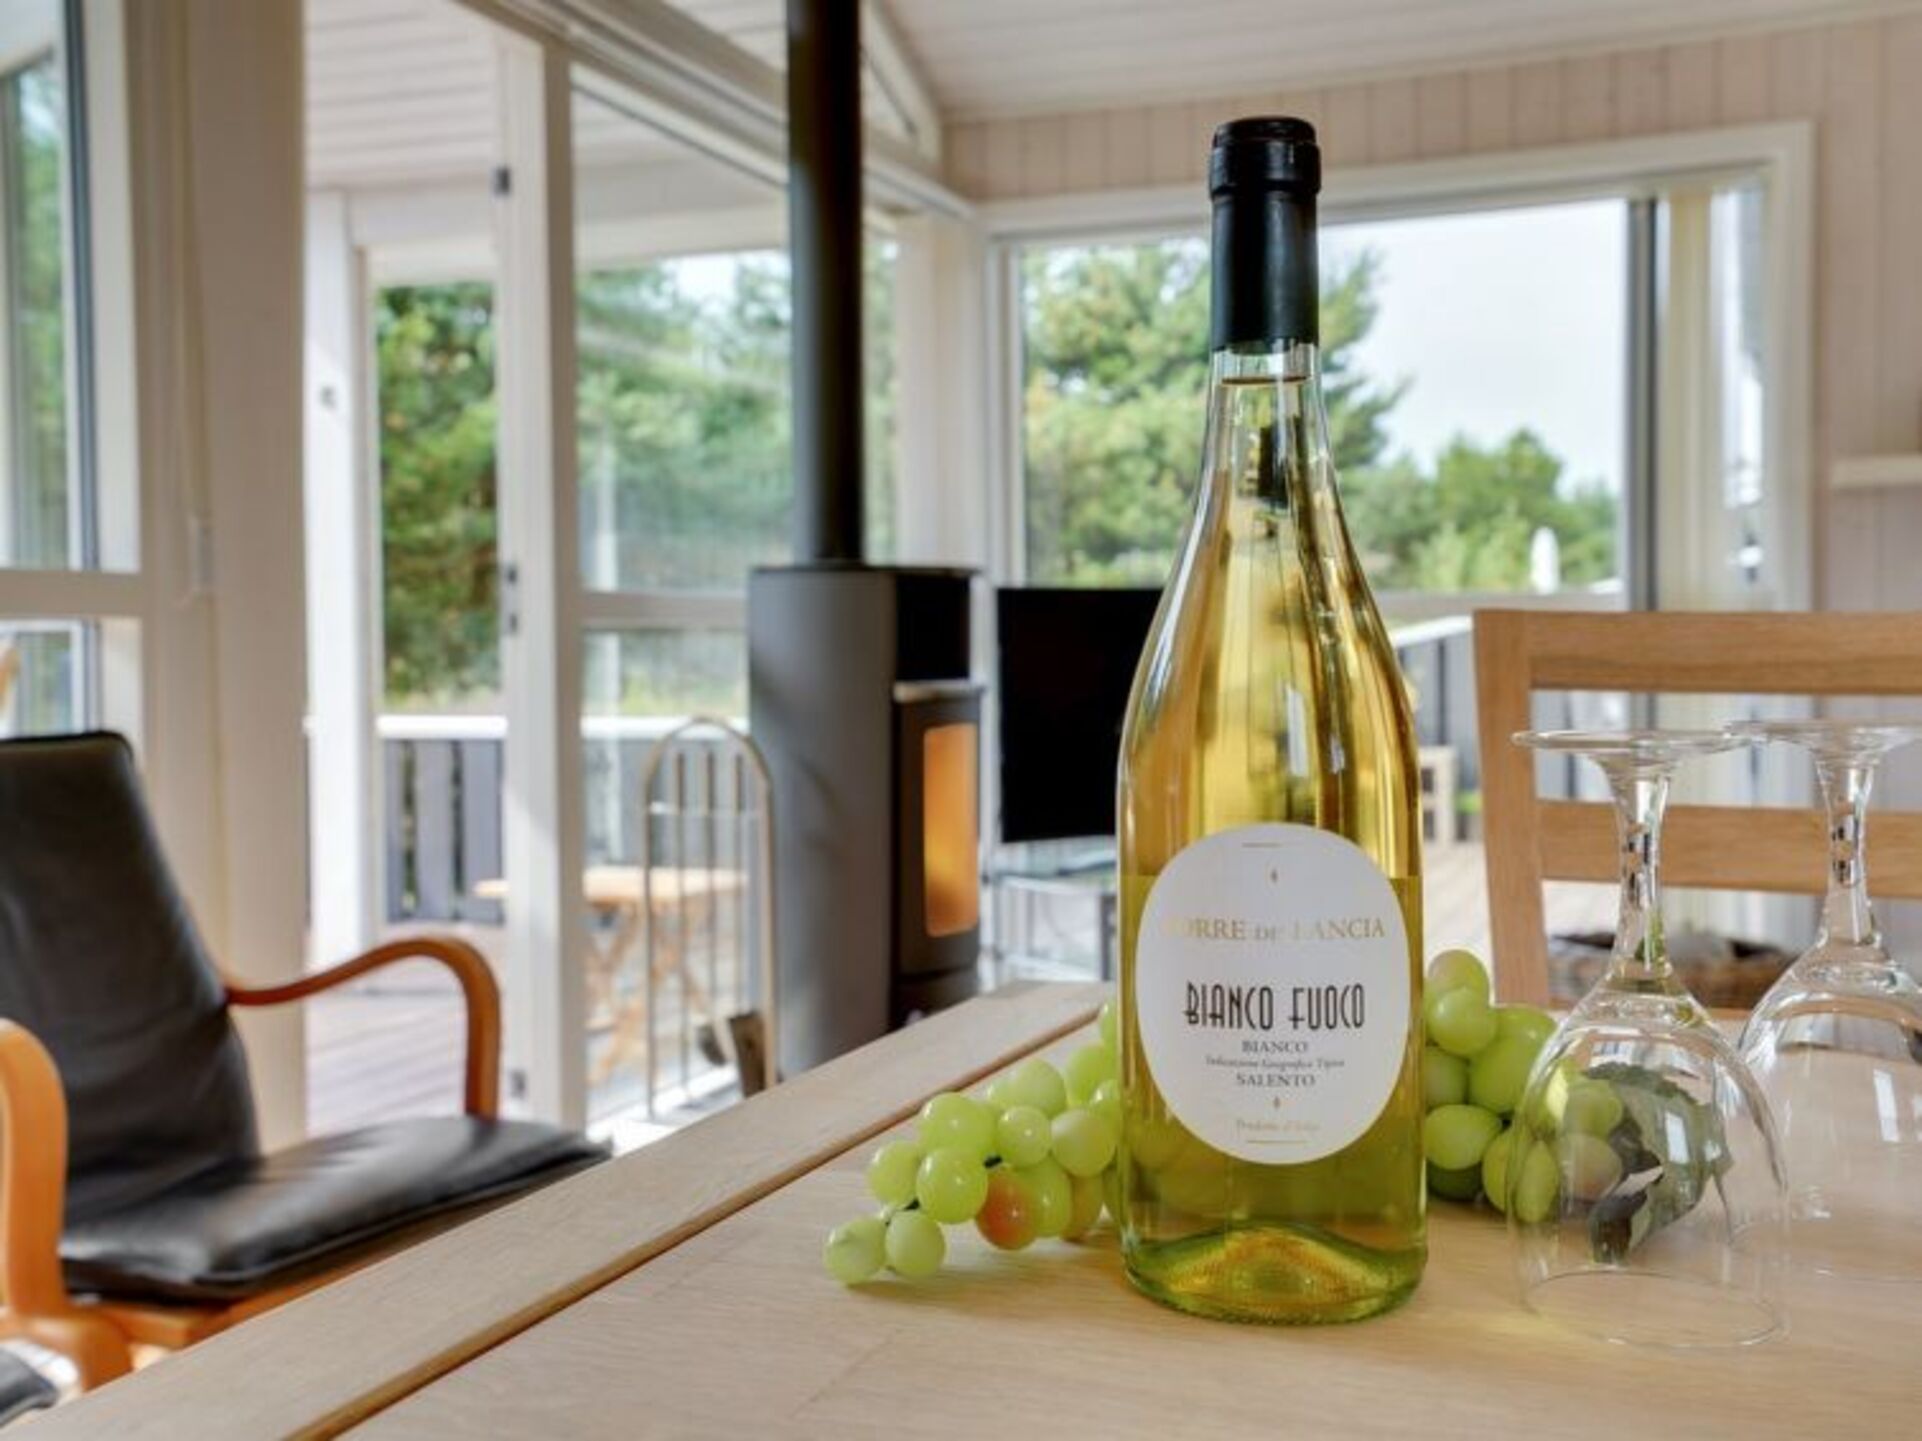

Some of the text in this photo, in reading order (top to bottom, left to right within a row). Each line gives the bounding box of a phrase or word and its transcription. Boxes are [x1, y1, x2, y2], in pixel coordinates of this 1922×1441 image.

[1168, 918, 1247, 941] ORRE
[1184, 981, 1366, 1031] BIANCO FUOCO
[1241, 1039, 1309, 1053] BIANCO
[1236, 1072, 1316, 1087] SALENTO
